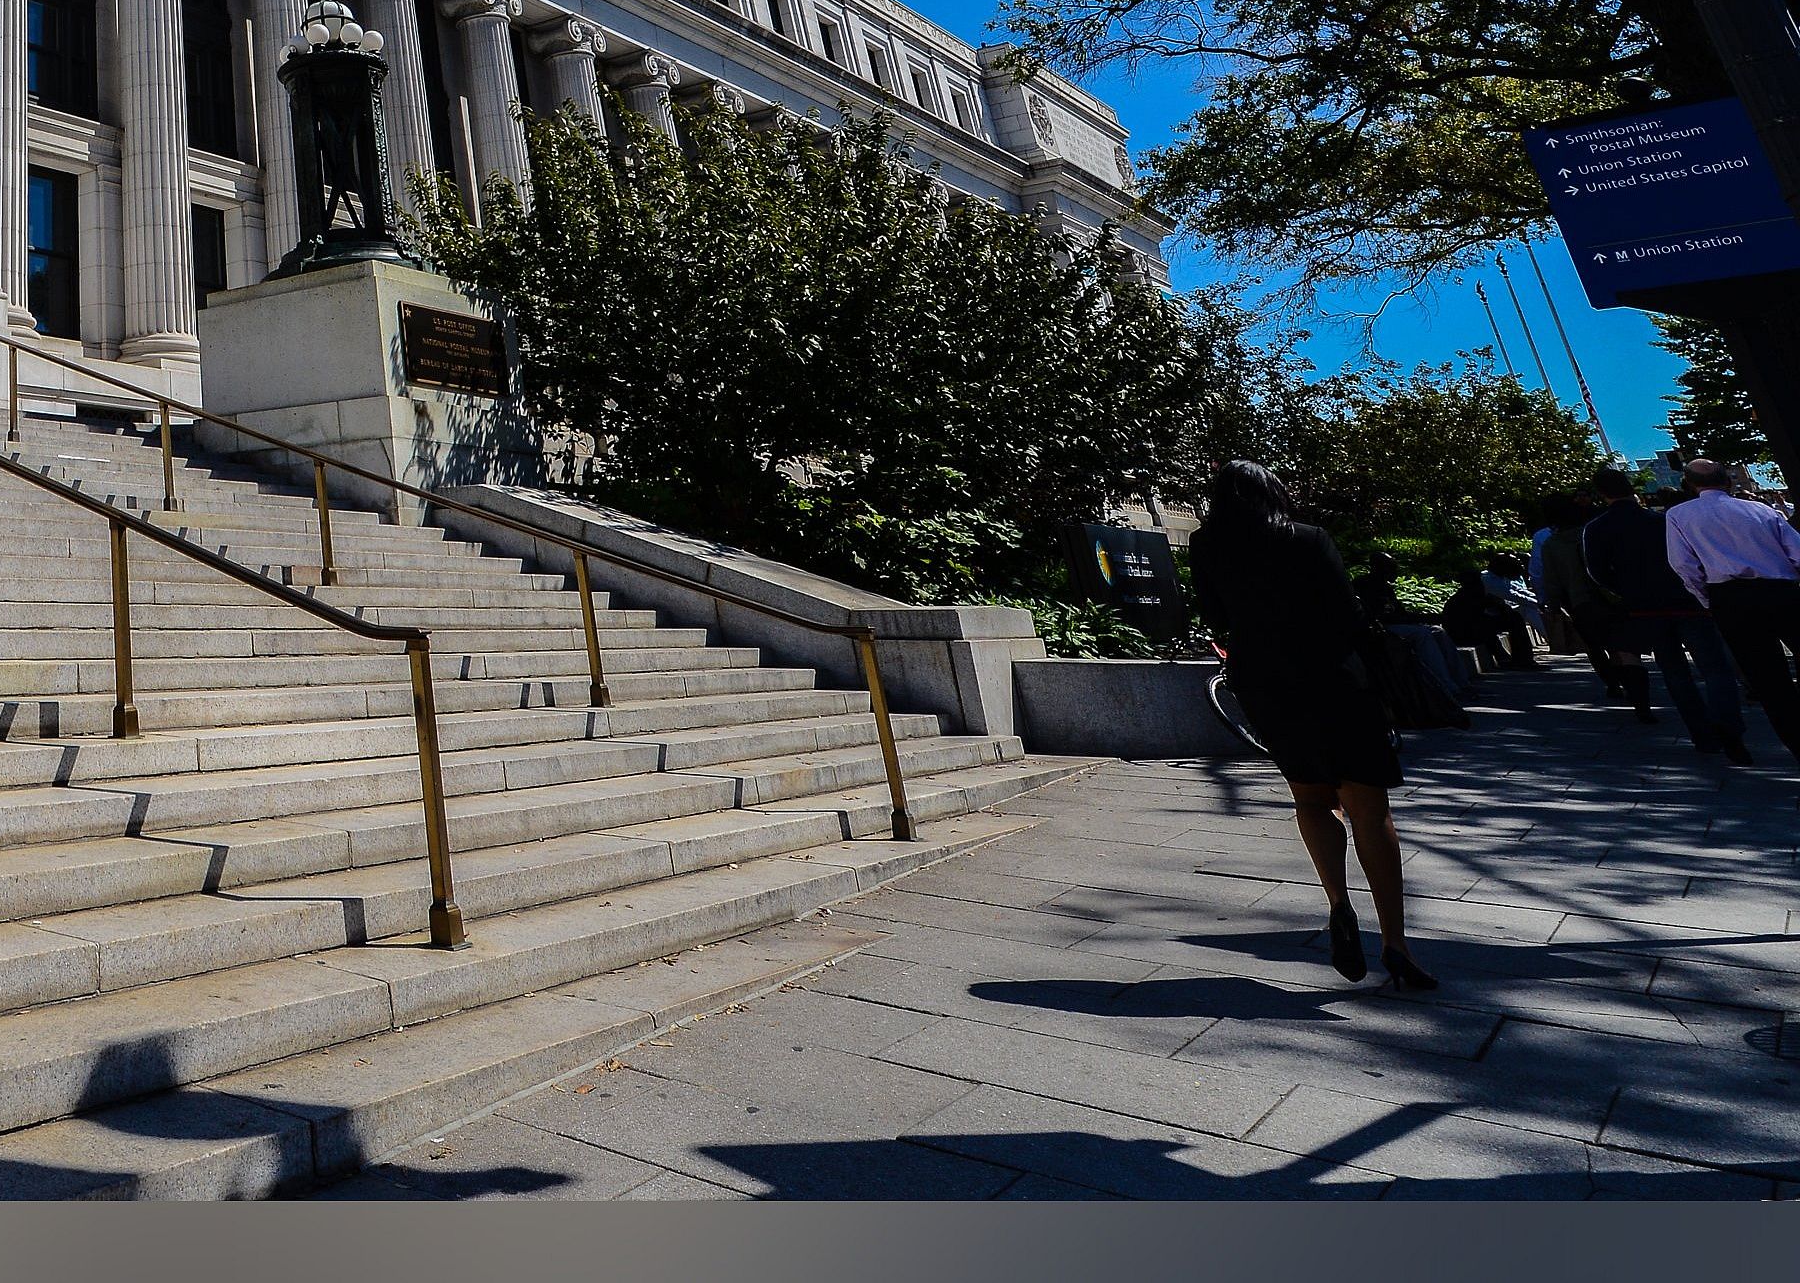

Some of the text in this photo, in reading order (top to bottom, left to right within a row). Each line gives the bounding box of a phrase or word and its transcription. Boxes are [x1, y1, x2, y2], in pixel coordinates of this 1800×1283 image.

[1565, 119, 1664, 146] Smithsonian:
[1589, 124, 1707, 154] Postal Museum
[1578, 148, 1683, 176] Union Station
[1586, 155, 1749, 193] United States Capitol
[1633, 242, 1682, 259] Union
[1684, 233, 1744, 252] Station
